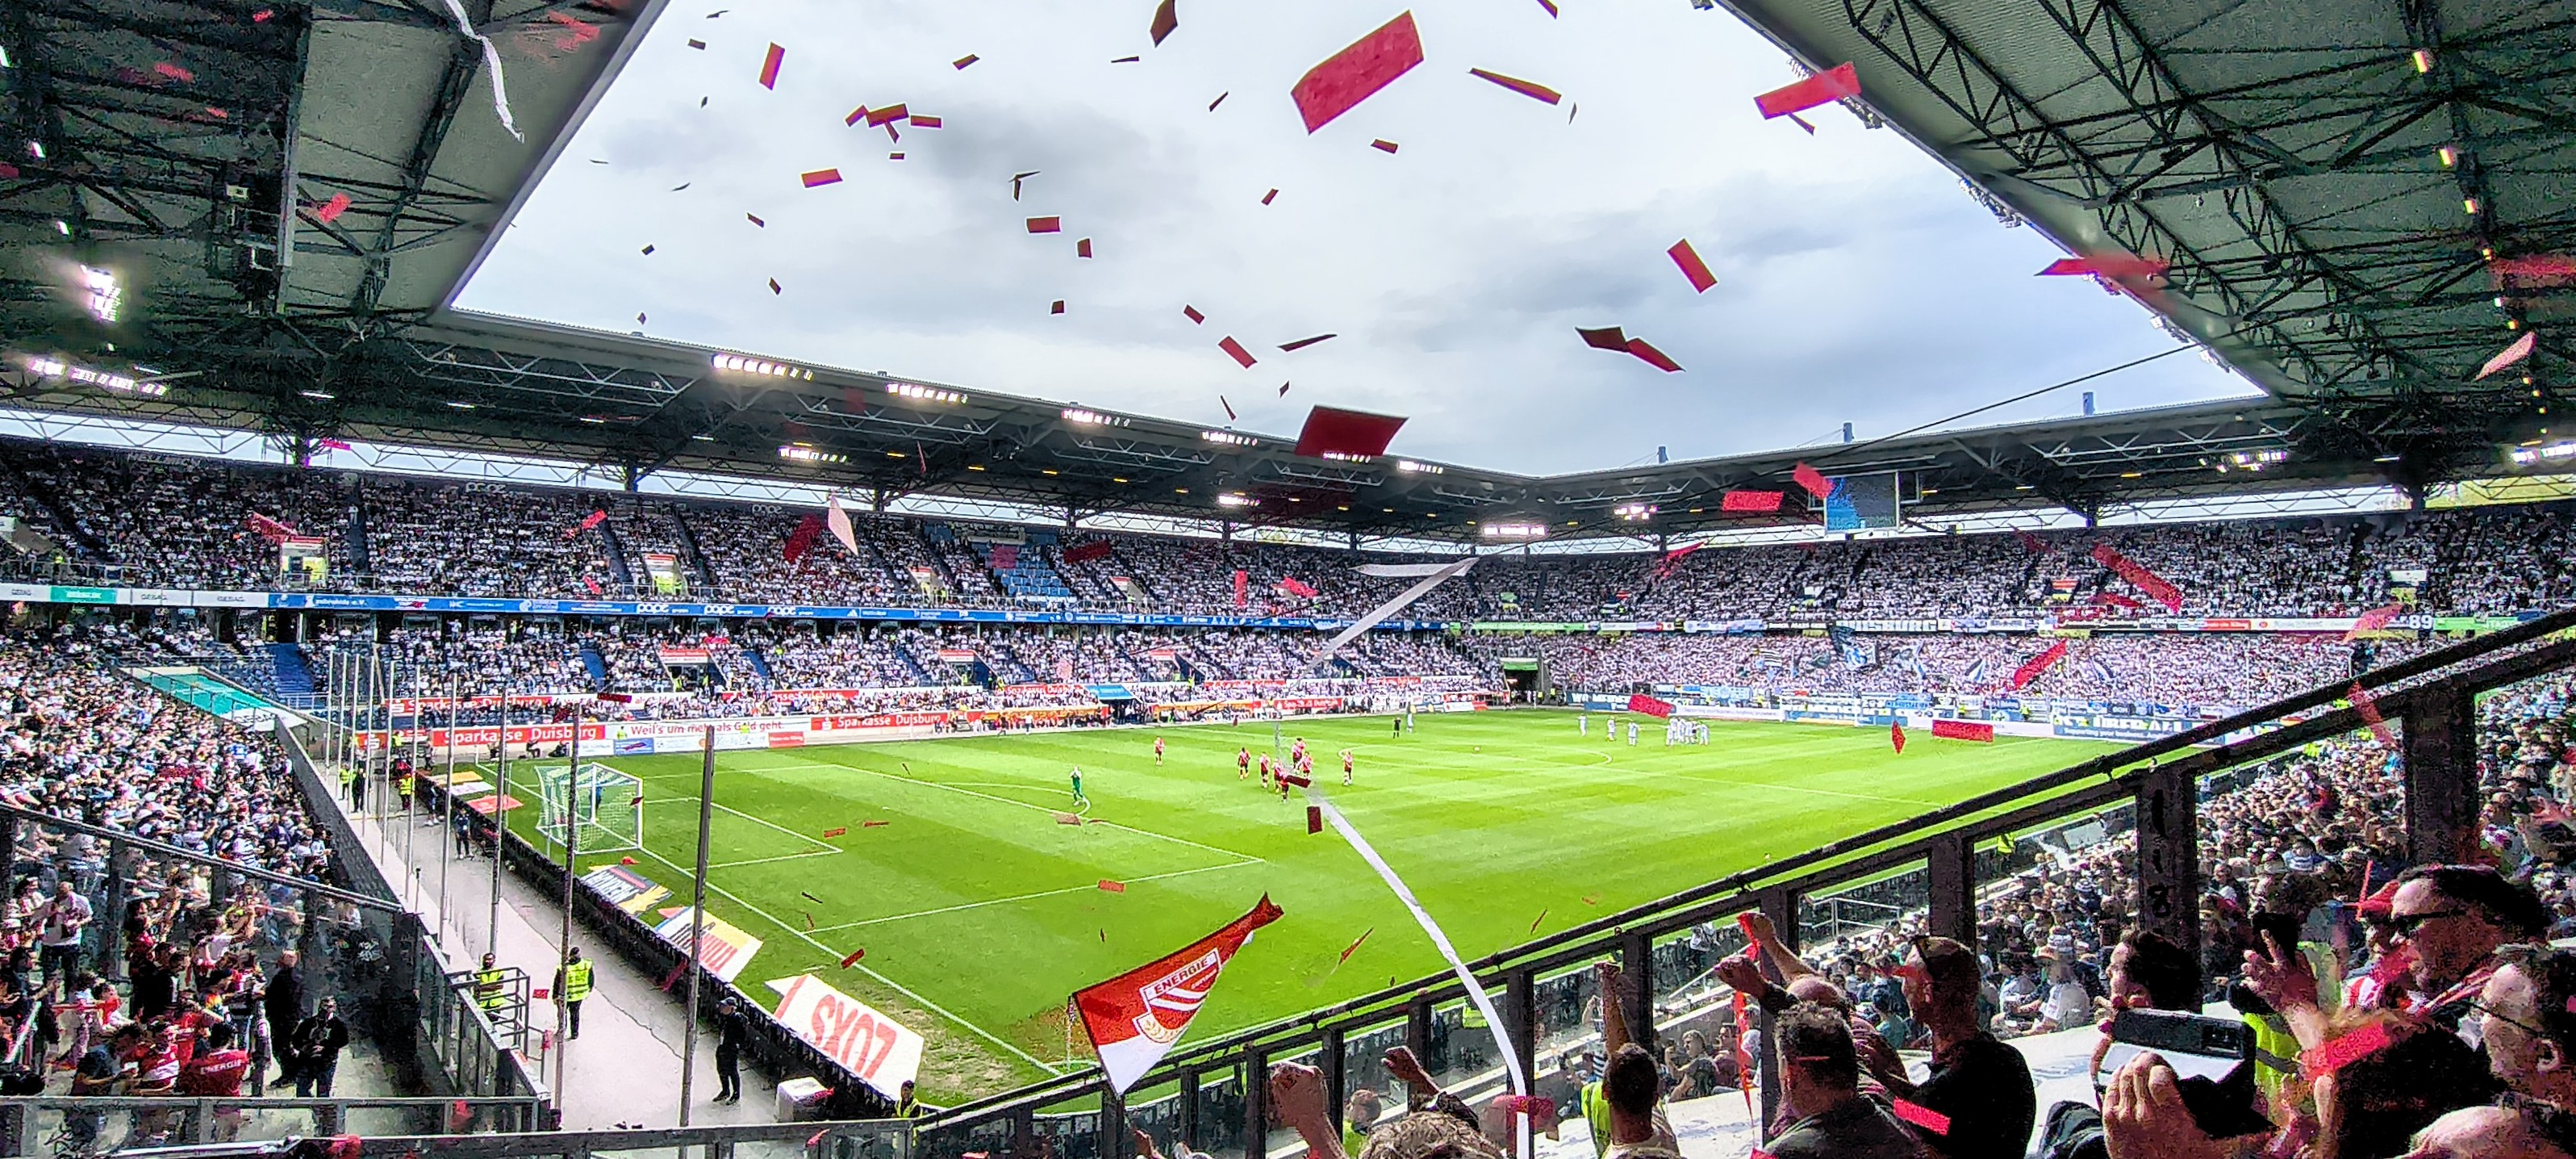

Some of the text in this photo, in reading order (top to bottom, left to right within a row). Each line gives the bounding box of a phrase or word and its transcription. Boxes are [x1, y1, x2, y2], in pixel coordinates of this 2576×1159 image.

[837, 715, 891, 729] Sparkasse
[445, 729, 523, 743] Sparkase
[1154, 958, 1209, 994] ENERGIE
